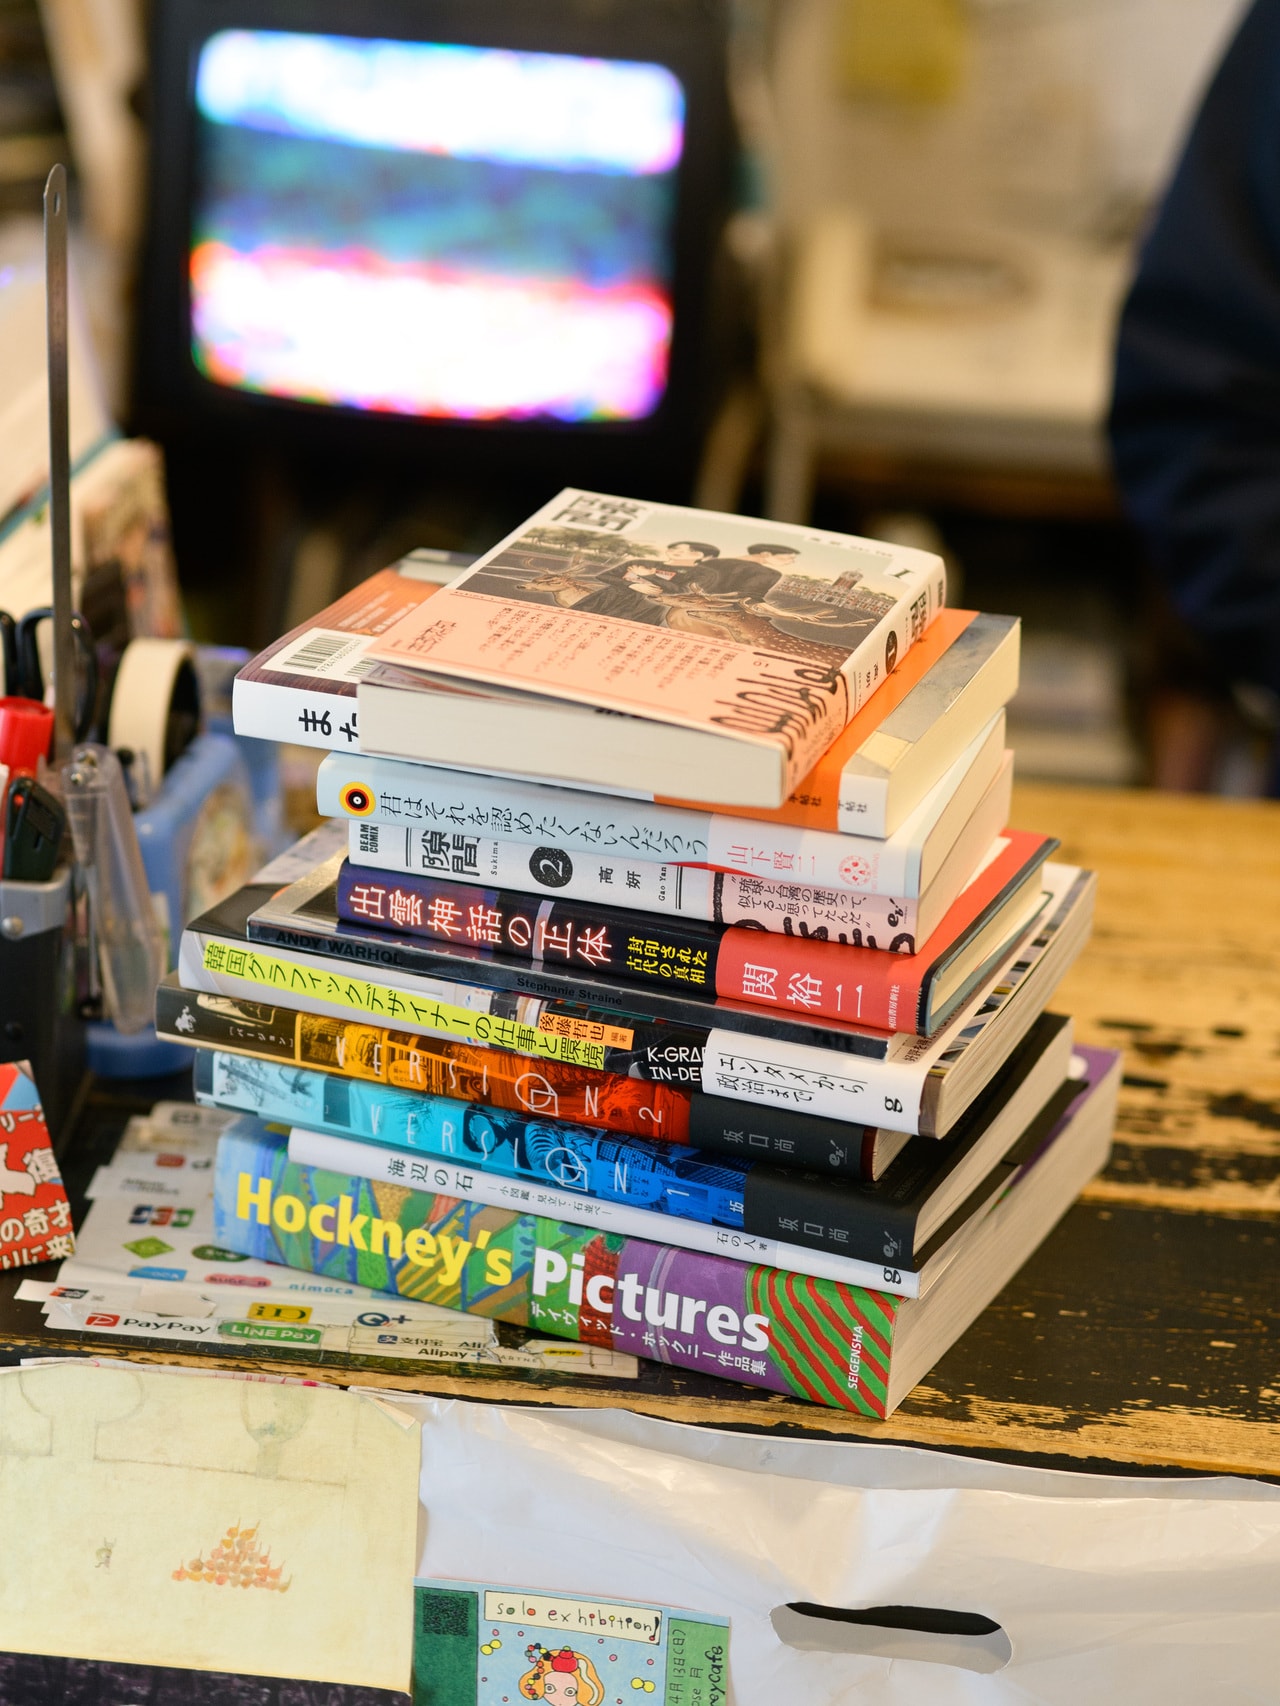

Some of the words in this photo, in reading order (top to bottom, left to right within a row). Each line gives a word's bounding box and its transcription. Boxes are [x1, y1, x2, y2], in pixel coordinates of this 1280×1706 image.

[380, 791, 708, 854] 君はそれを認めたくないんだろう
[359, 823, 370, 852] BEAM
[369, 825, 379, 853] COMIX
[490, 841, 499, 876] Sukima
[727, 845, 816, 876] 山下賢二
[659, 866, 667, 882] Yan
[658, 884, 666, 901] Gao
[350, 886, 612, 966] 出雲神話の正体
[275, 929, 323, 949] ANDY
[328, 940, 404, 965] WARHOL
[627, 936, 708, 966] 封印された
[626, 954, 706, 984] 古代の真相
[516, 977, 574, 997] Stephanie
[578, 988, 622, 1005] Straine
[742, 962, 864, 1018] 関裕二
[204, 944, 604, 1068] 韓国グラフィックデザイナーの仕事と環境
[539, 1013, 605, 1041] 後藤哲也
[647, 1046, 706, 1062] K-GRA
[649, 1066, 703, 1081] IN-DE
[720, 1057, 865, 1095] エンタメから
[717, 1074, 813, 1102] 政治まで
[639, 1107, 662, 1123] 2
[723, 1129, 795, 1153] 坂口尚
[388, 1158, 473, 1192] 海辺の石
[668, 1181, 690, 1196] 1
[716, 1231, 757, 1250] 石の人
[779, 1217, 849, 1243] 坂口尚
[236, 1172, 512, 1287] Hockney's
[532, 1247, 771, 1352] Pictures
[123, 1318, 210, 1335] PayPay
[230, 1325, 276, 1340] LINE
[279, 1329, 317, 1342] Pay
[418, 1347, 467, 1360] Alipay
[848, 1325, 864, 1390] SEIGENSHA
[496, 1601, 537, 1617] solo
